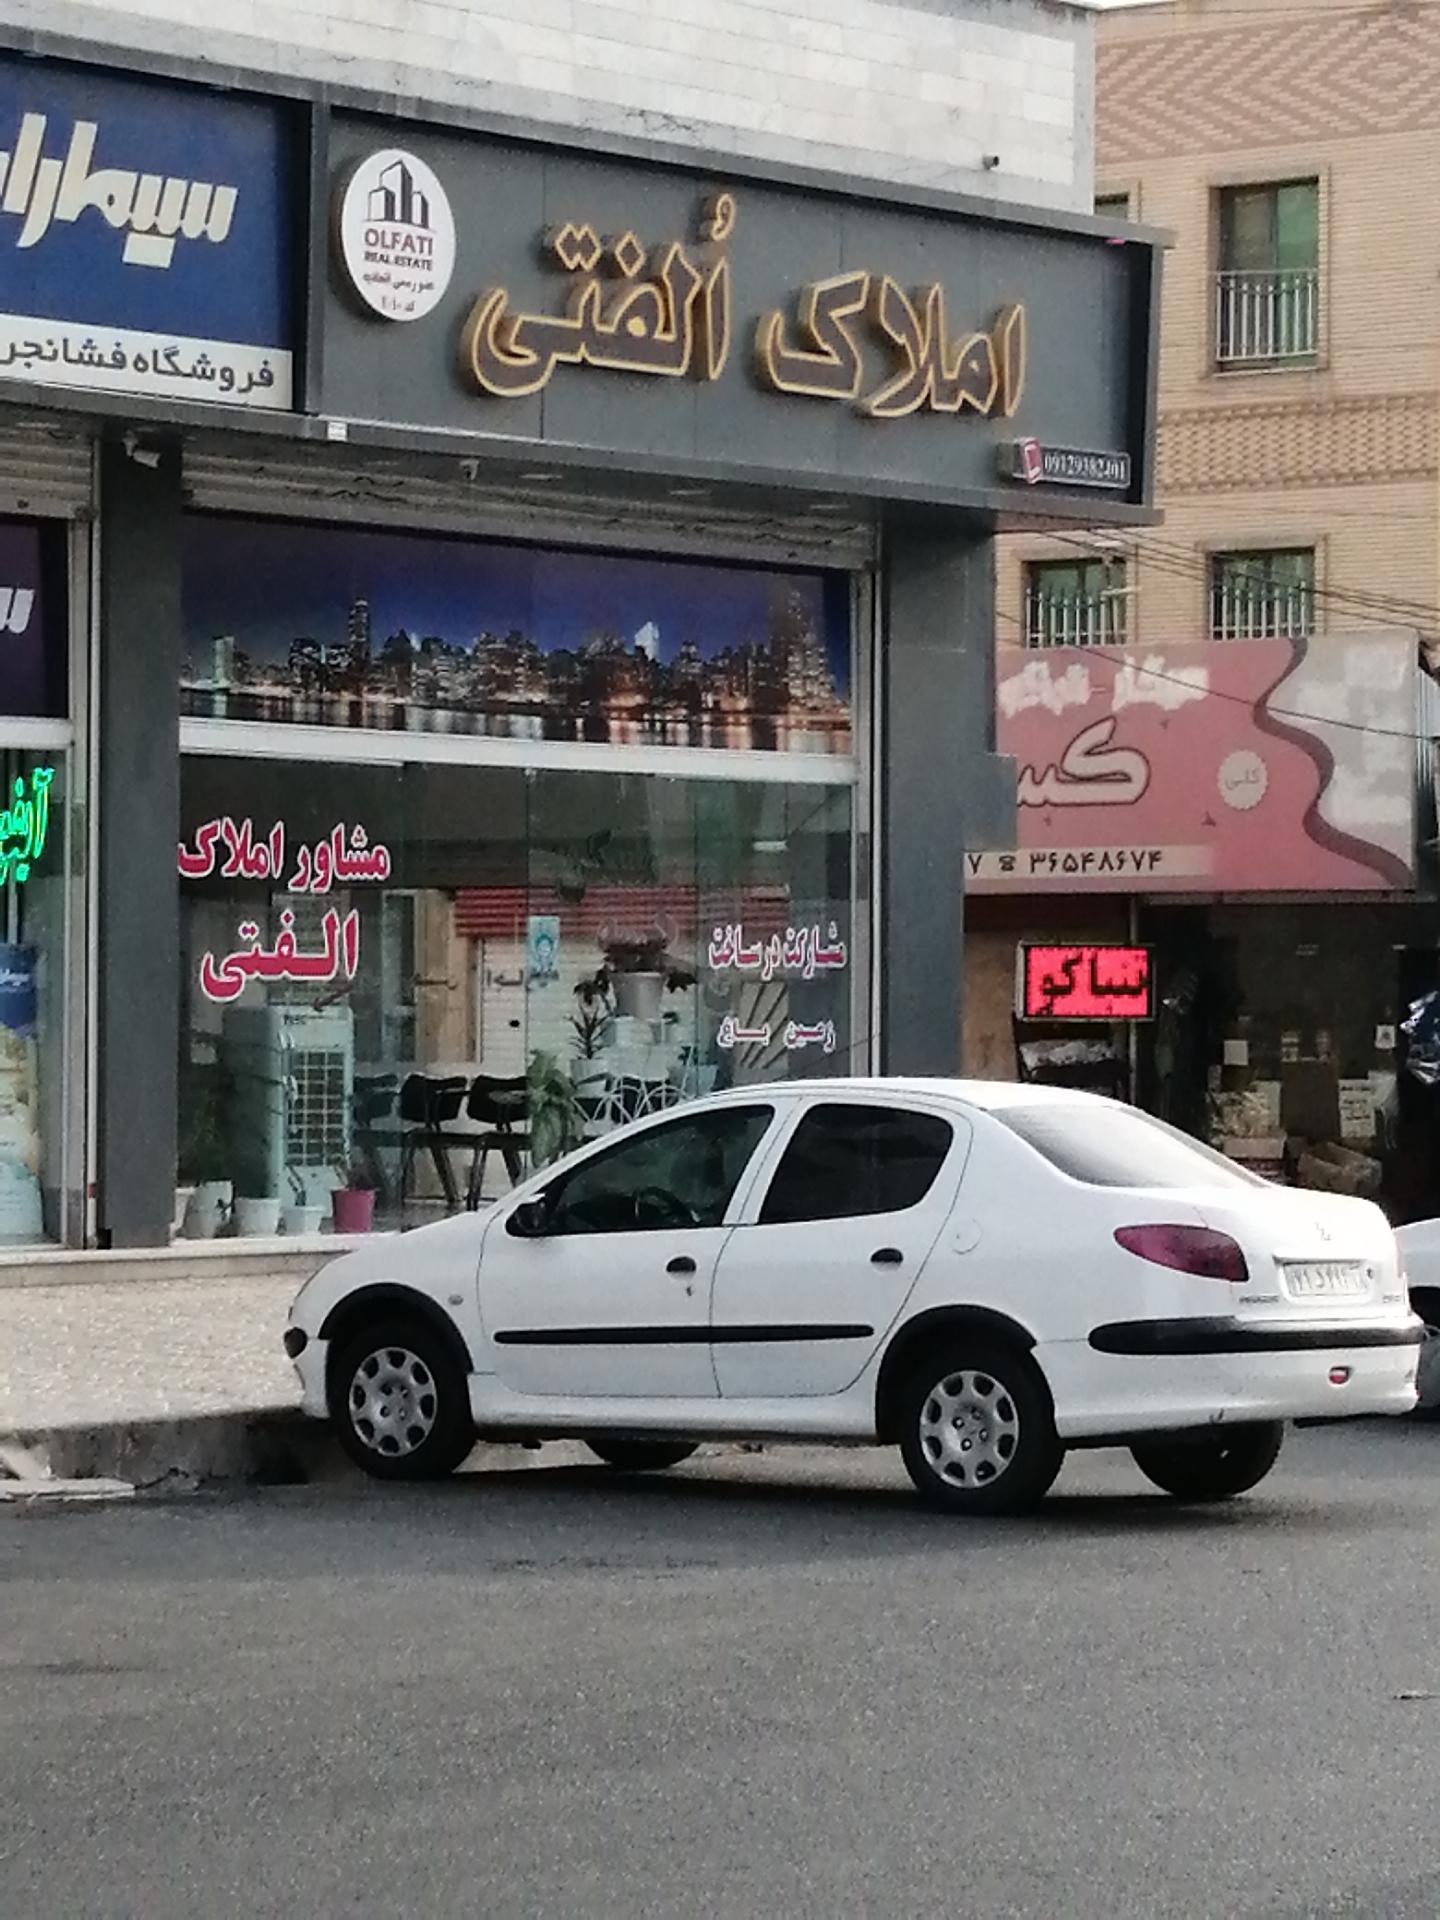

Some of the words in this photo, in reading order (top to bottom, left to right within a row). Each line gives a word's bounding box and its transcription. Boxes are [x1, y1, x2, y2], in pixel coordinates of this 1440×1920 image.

[0, 112, 238, 269] سیمارا
[364, 228, 433, 257] OLFATI
[394, 254, 433, 272] ESTATE
[133, 346, 275, 393] فروشگاه
[764, 270, 1026, 417] املاک
[177, 816, 285, 878] املاک
[287, 822, 391, 893] مشاور
[200, 907, 360, 1002] الفتی
